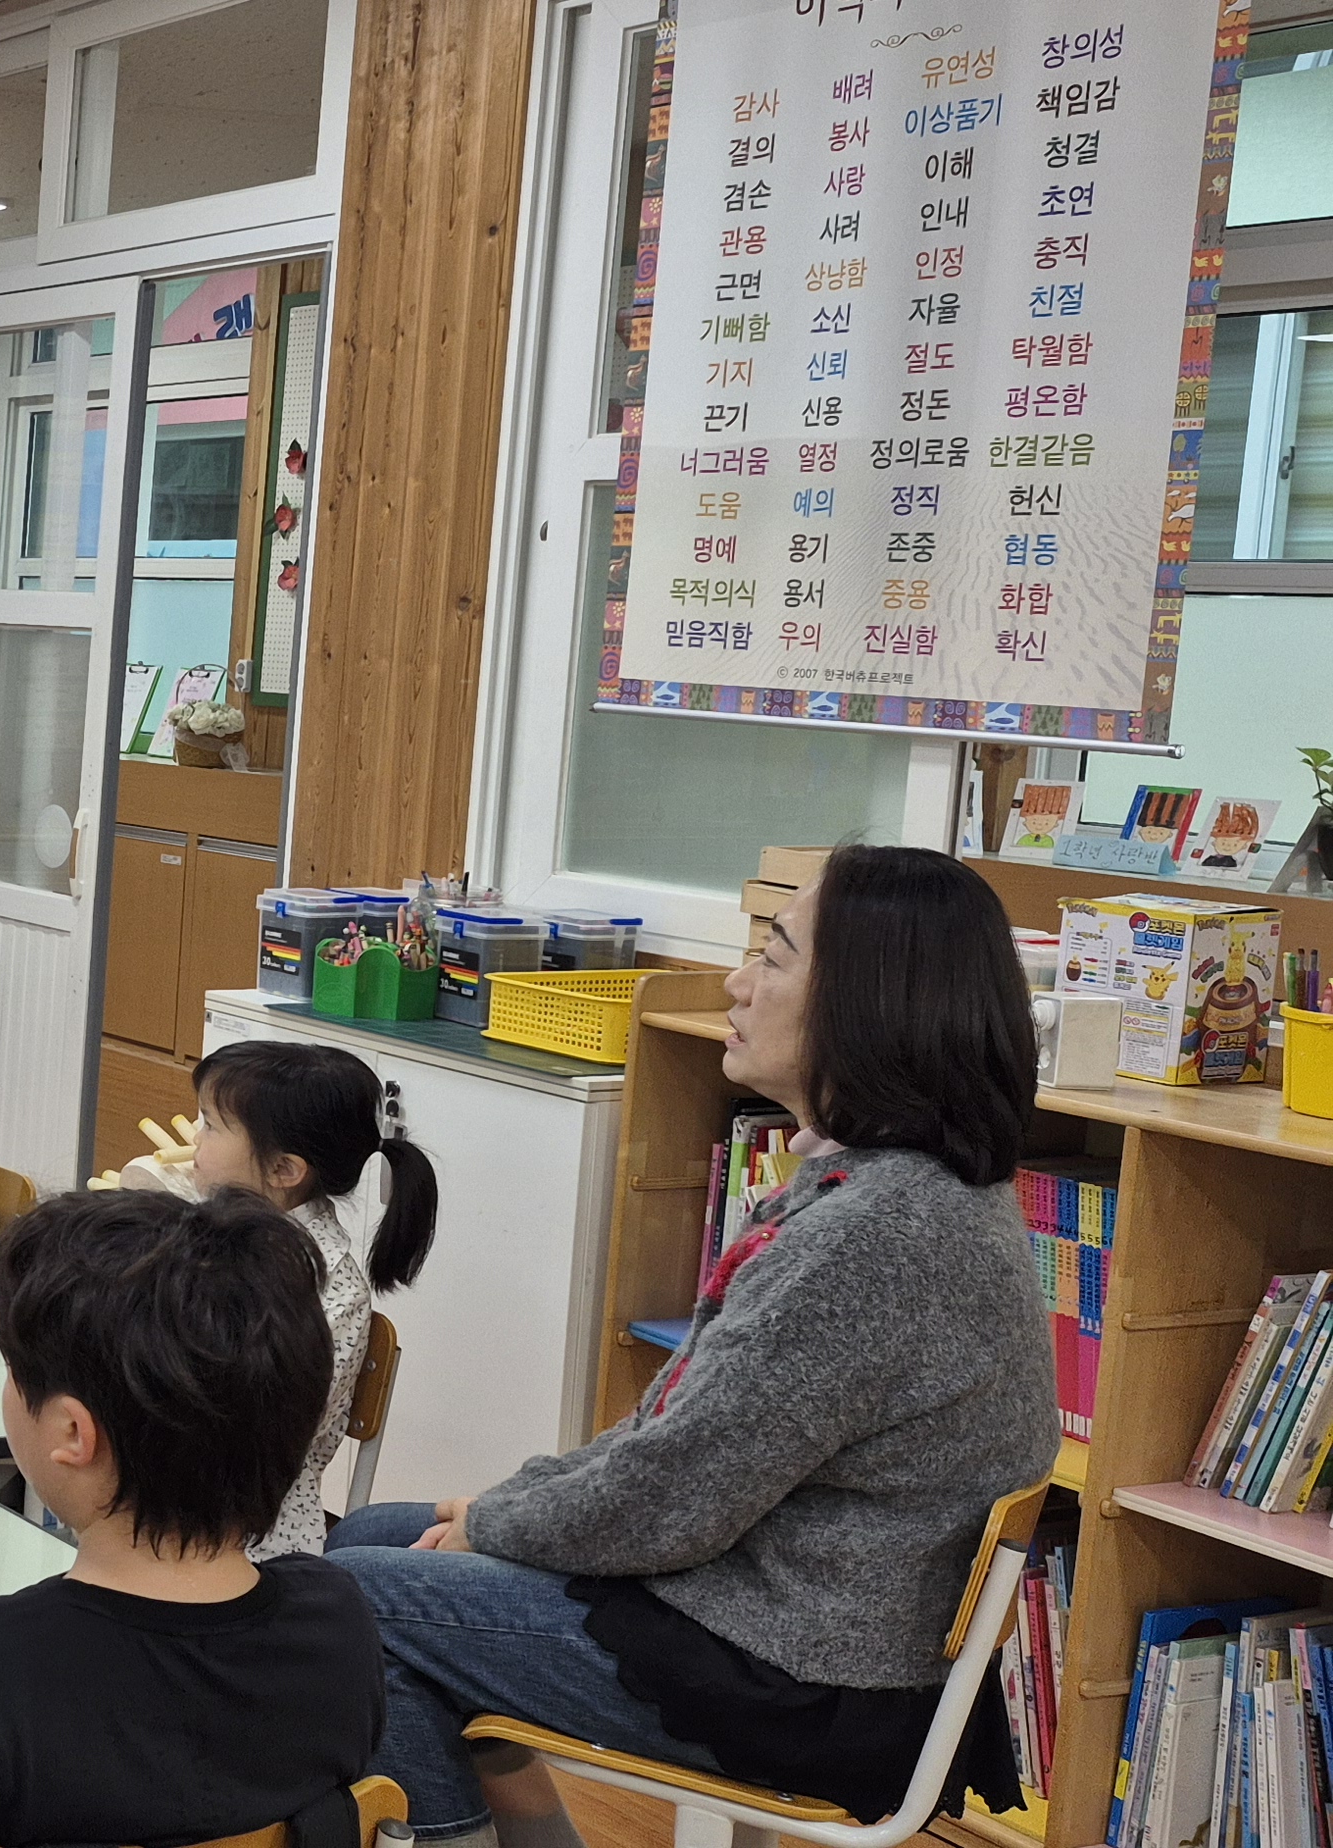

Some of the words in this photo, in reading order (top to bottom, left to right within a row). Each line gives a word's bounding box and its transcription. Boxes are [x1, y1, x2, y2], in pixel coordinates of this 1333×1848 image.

[1042, 24, 1124, 69] 창의성
[921, 46, 995, 89] 유연성
[833, 69, 873, 104] 배려
[1036, 76, 1120, 118] 책임감
[733, 88, 779, 123] 감사
[905, 93, 1002, 137] 이상품기
[729, 133, 775, 167] 결의
[829, 117, 869, 152] 봉사
[1044, 130, 1100, 168] 청결
[824, 164, 865, 197] 사랑
[925, 147, 973, 182] 이해
[724, 180, 771, 212] 겸손
[1038, 182, 1094, 216] 초연
[820, 211, 860, 244] 사려
[921, 196, 969, 232] 인내
[720, 226, 766, 256] 관용
[1034, 233, 1088, 269] 충직
[805, 257, 868, 291] 상냥함
[916, 245, 963, 280] 인정
[716, 270, 761, 301] 근면
[1029, 282, 1083, 318] 친절
[811, 303, 851, 334] 소신
[909, 293, 960, 325] 자율
[700, 312, 770, 344] 기뻐함
[807, 349, 847, 381] 신뢰
[905, 343, 954, 374] 절도
[1012, 332, 1093, 368] 탁월함
[706, 358, 753, 388] 기지
[802, 397, 842, 427] 신용
[900, 389, 950, 421] 정돈
[1005, 383, 1087, 418] 평온함
[704, 402, 748, 432] 끈기
[681, 447, 769, 476] 너그러움
[799, 442, 837, 472] 열정
[871, 437, 969, 469] 정의로움
[990, 433, 1095, 467] 한결같음
[696, 492, 741, 520] 도움
[794, 488, 834, 517] 예의
[891, 485, 939, 516] 정직
[1009, 484, 1062, 516] 헌신
[694, 535, 737, 564] 명예
[789, 534, 828, 563] 용기
[887, 532, 935, 562] 존중
[1005, 534, 1058, 566] 협동
[670, 578, 756, 608] 목적의식
[784, 579, 824, 608] 용서
[881, 579, 930, 610] 중용
[998, 583, 1053, 615] 화합
[666, 620, 753, 650] 믿음직함
[779, 622, 821, 652] 우의
[864, 624, 938, 656] 진실함
[995, 630, 1046, 662] 확신
[793, 668, 818, 679] 2007
[1059, 840, 1102, 860] 1학년
[1149, 918, 1186, 936] 포켓몬
